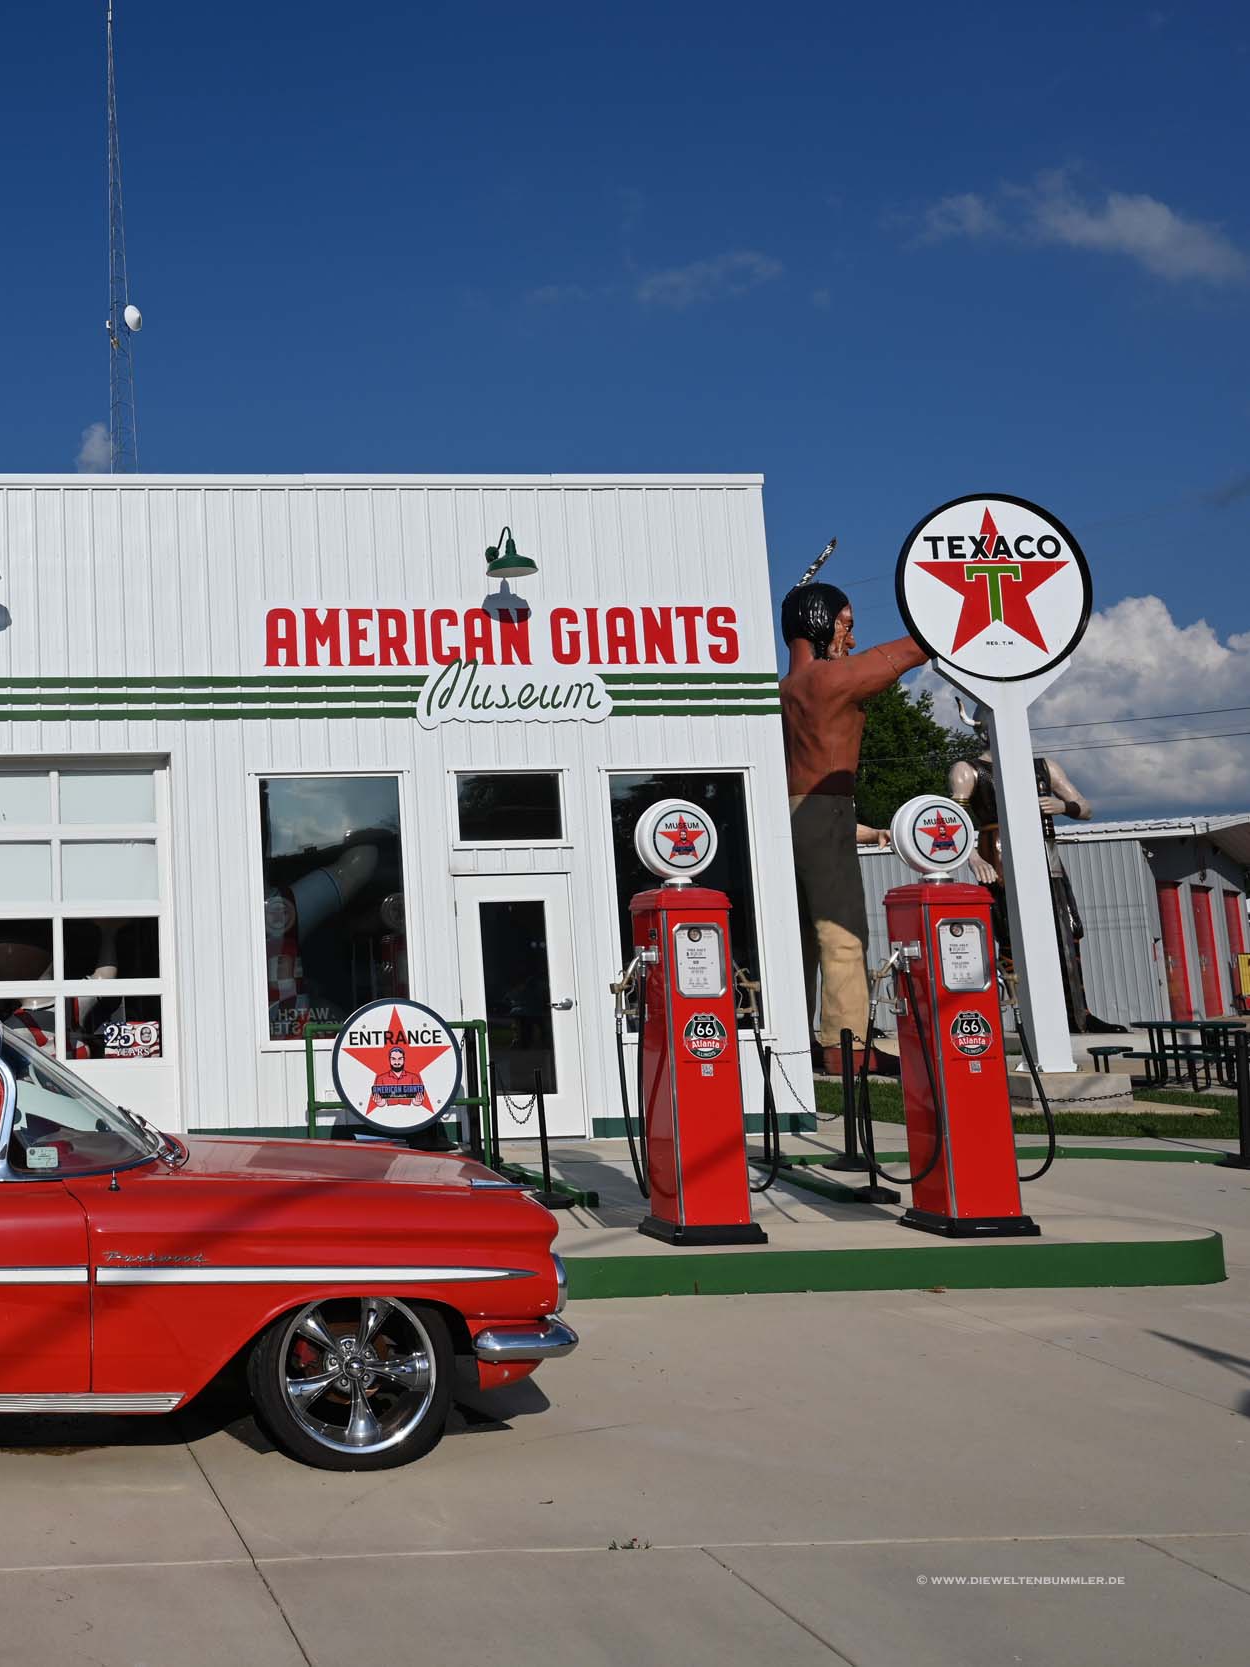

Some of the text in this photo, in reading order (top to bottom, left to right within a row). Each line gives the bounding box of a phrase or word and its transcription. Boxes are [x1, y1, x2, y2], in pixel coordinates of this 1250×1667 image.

[923, 535, 1061, 559] TEXACO
[964, 564, 1021, 623] T
[264, 606, 740, 666] AMERICAN GIANTS
[427, 658, 601, 716] Museum
[665, 822, 700, 830] MUSEUM
[923, 817, 957, 826] MUSEUM
[696, 1023, 714, 1036] 66
[962, 1020, 979, 1033] 66
[106, 1024, 157, 1047] 250
[349, 1029, 442, 1046] ENTRANCE
[958, 1036, 986, 1046] Atlanta
[691, 1040, 720, 1049] Atlanta
[117, 1048, 150, 1056] YEARS
[372, 1086, 401, 1094] AMERICAN
